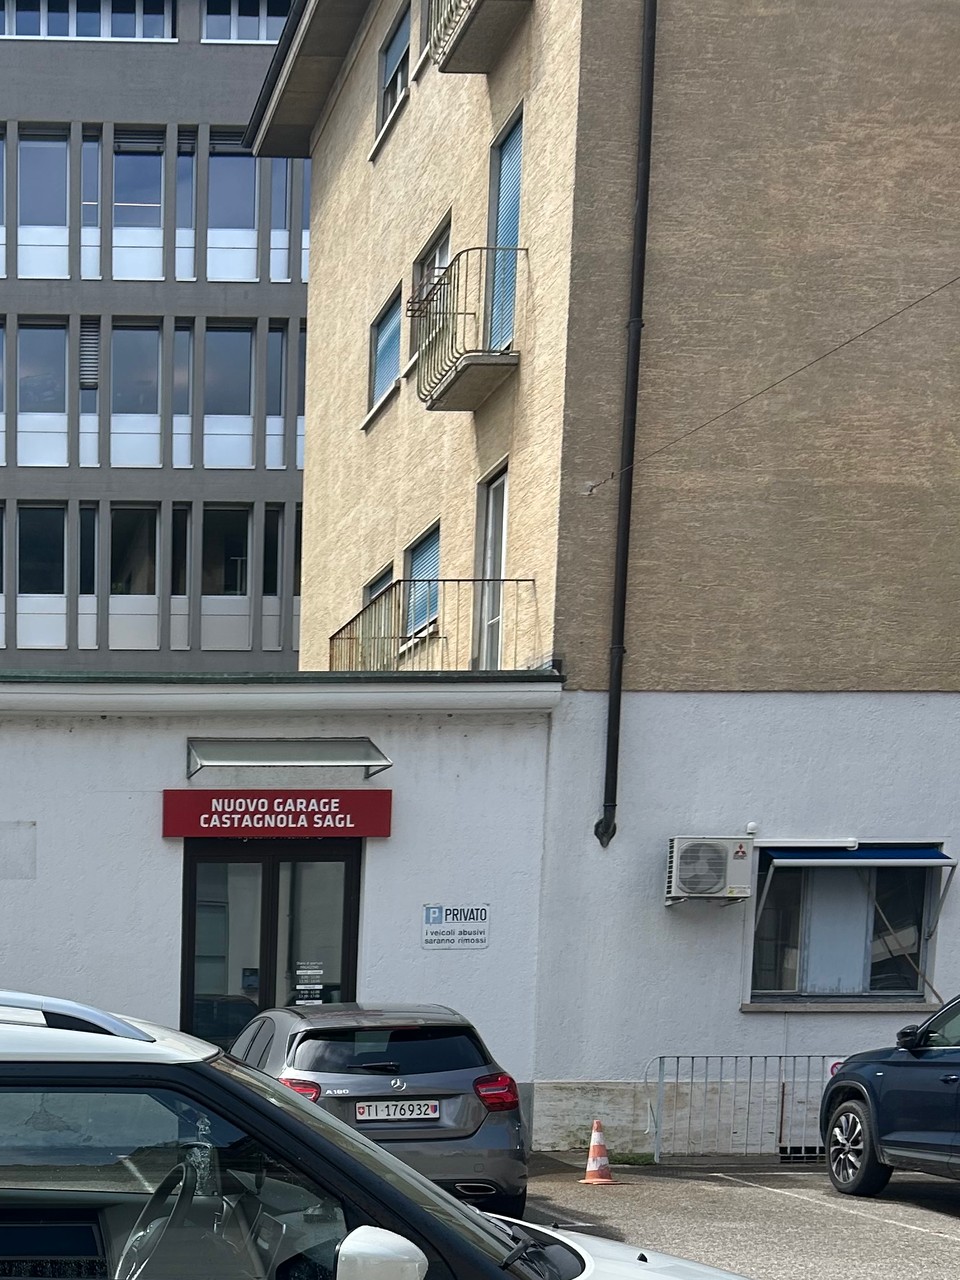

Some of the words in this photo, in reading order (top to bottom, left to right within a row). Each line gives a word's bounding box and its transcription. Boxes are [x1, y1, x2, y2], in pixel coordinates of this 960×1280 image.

[211, 798, 269, 812] NUOVO
[273, 798, 340, 812] GARAGE
[199, 814, 308, 828] CASTAGNOLA
[313, 814, 355, 828] SAGL
[445, 908, 487, 921] PRIVATO
